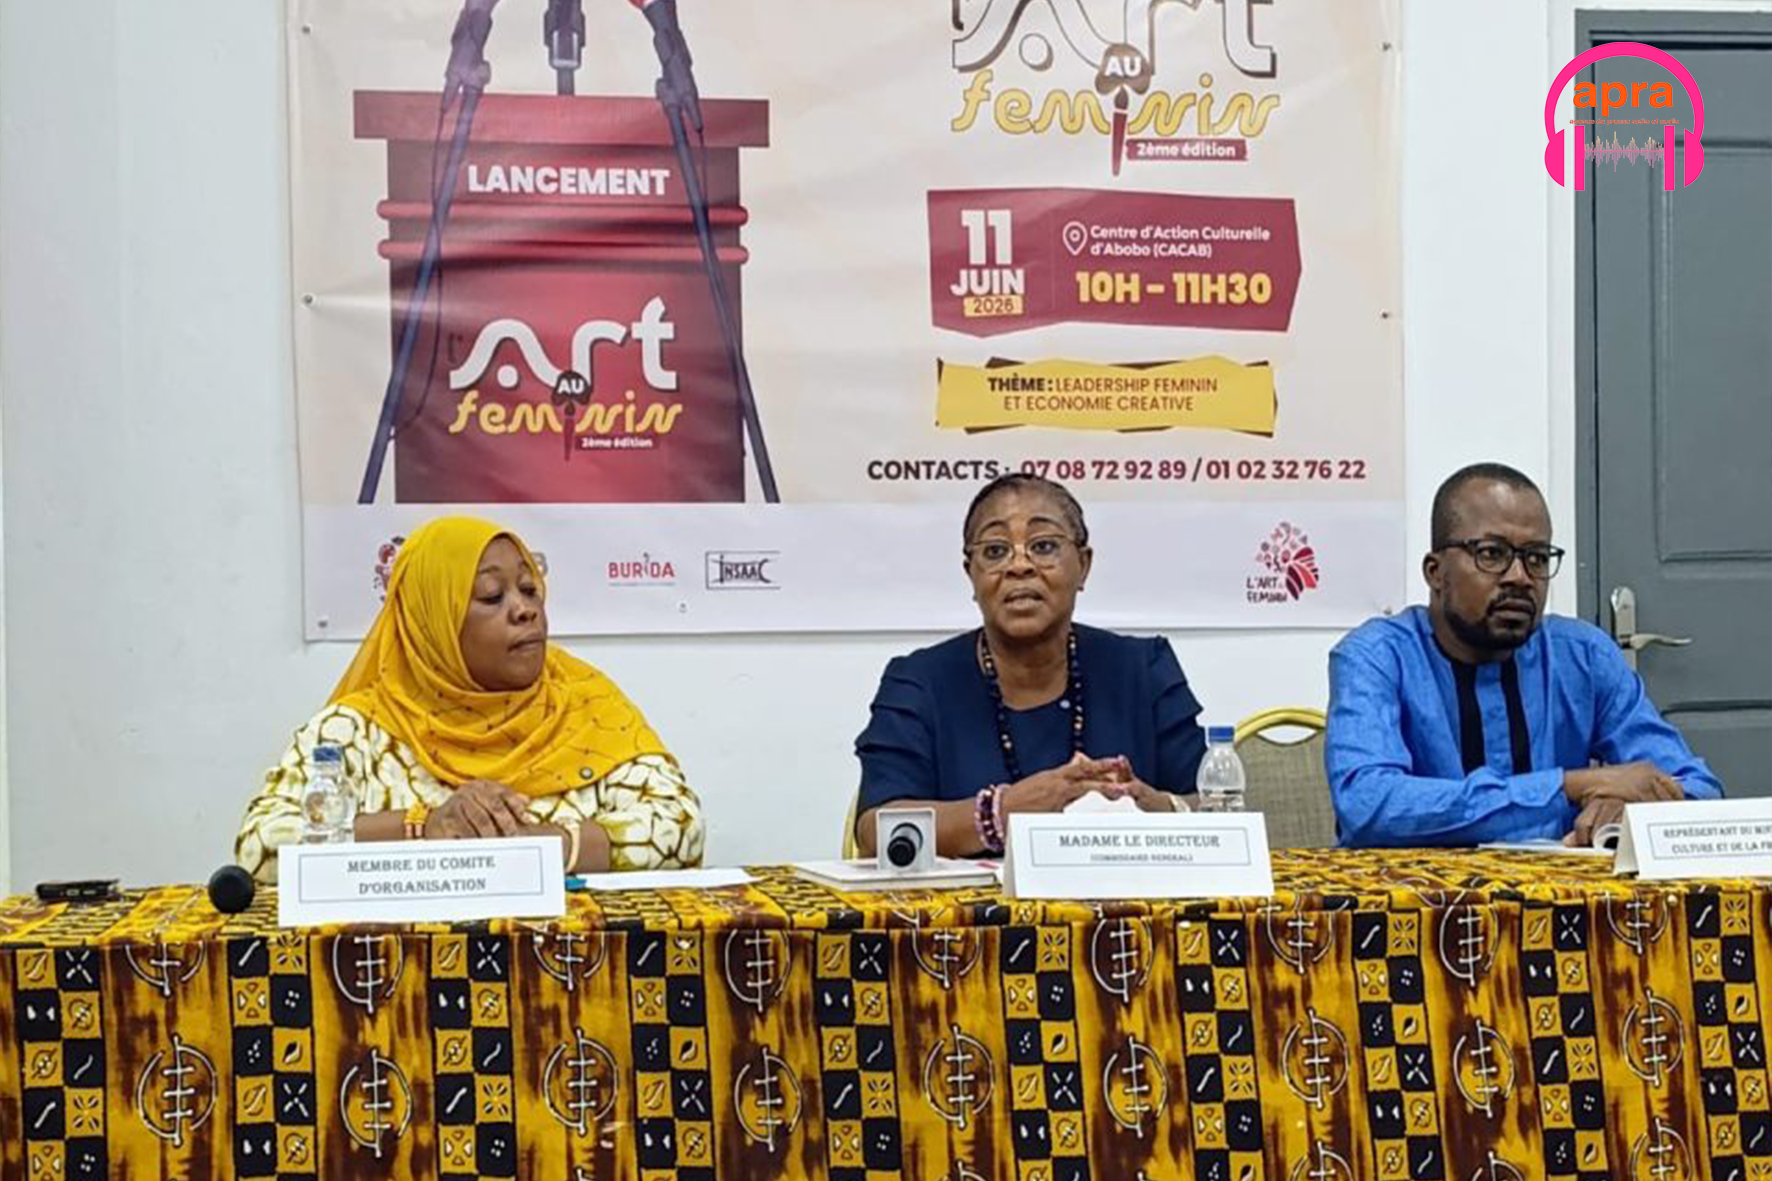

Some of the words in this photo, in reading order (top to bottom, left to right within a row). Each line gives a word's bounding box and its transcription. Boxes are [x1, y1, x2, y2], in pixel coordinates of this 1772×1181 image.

[1104, 55, 1142, 77] AU
[1136, 141, 1180, 157] 2ème
[1182, 141, 1236, 158] édition
[467, 164, 671, 196] LANCEMENT
[961, 209, 1012, 266] 11
[1090, 224, 1138, 239] Centre
[1140, 224, 1199, 240] d'Action
[1202, 226, 1270, 241] Culturelle
[1090, 242, 1151, 256] d'Abobo
[1153, 242, 1212, 259] (CACAB)
[950, 268, 1025, 296] JUIN
[1075, 271, 1141, 304] 10H
[1172, 272, 1272, 305] 11H30
[973, 297, 1014, 314] 2026
[557, 378, 584, 394] AU
[1055, 377, 1150, 393] LEADERSHIP
[1154, 377, 1218, 393] FEMININ
[1004, 396, 1020, 411] ET
[1026, 396, 1112, 411] ECONOMIE
[1116, 396, 1194, 411] CREATIVE
[581, 437, 612, 448] 2ème
[614, 437, 653, 448] édition
[1020, 460, 1051, 479] 07
[1056, 460, 1086, 480] 08
[1091, 460, 1119, 480] 72
[1124, 460, 1152, 480] 92
[1158, 460, 1187, 480] 89
[1206, 460, 1230, 480] 01
[1237, 460, 1266, 480] 02
[1271, 460, 1299, 480] 32
[1304, 460, 1332, 480] 76
[1338, 460, 1366, 480] 22
[1059, 835, 1121, 847] MADAME
[1124, 835, 1140, 847] LE
[1145, 835, 1220, 847] DIRECTEUR
[347, 859, 413, 873] MEMBRE
[416, 858, 437, 871] DU
[440, 856, 496, 870] COMITE
[358, 878, 487, 895] D'ORGANISATION
